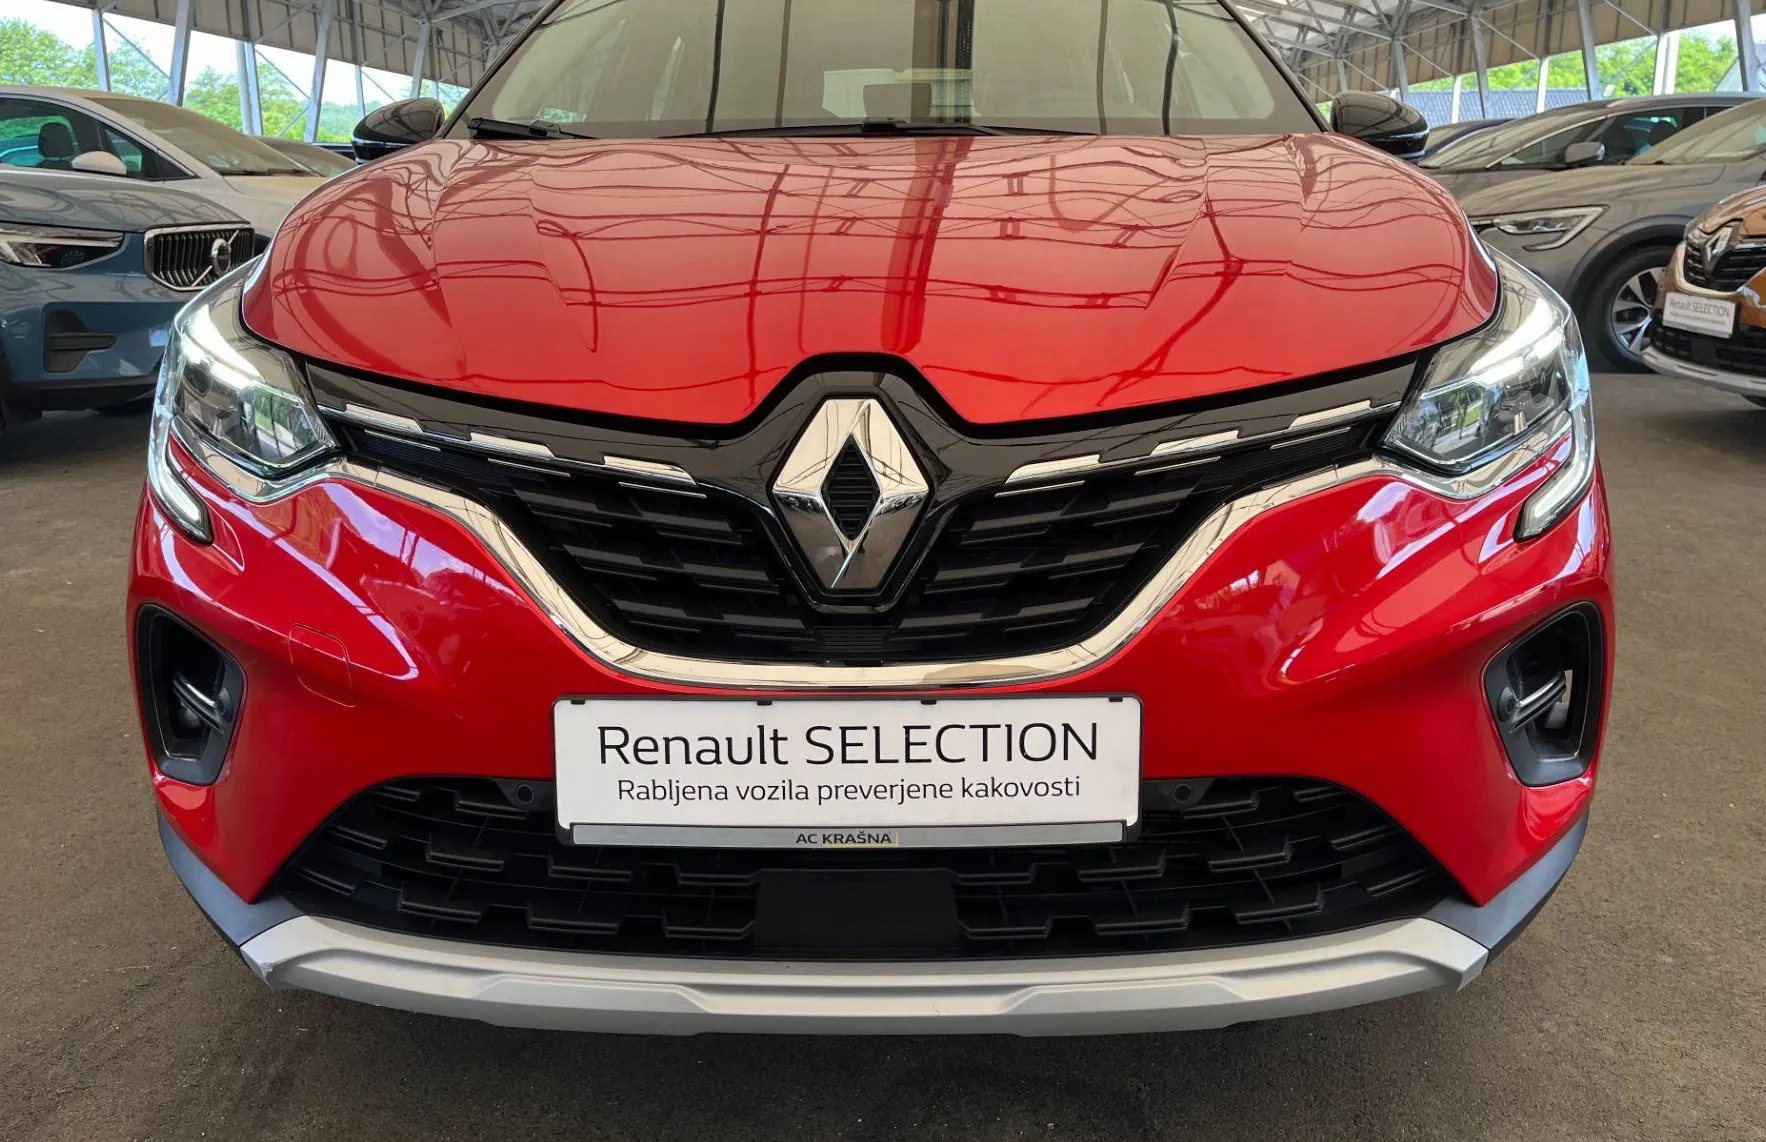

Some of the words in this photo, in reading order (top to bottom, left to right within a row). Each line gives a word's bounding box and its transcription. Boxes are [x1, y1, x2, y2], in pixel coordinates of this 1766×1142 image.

[1692, 302, 1730, 317] SELECTION
[598, 724, 789, 766] Renault
[805, 722, 1097, 766] SELECTION
[617, 778, 729, 807] Rabljena
[735, 778, 810, 801] vozila
[817, 777, 953, 806] preverjene
[961, 775, 1080, 798] kakovosti
[795, 833, 818, 845] AC
[821, 830, 892, 845] KRAŠNA
